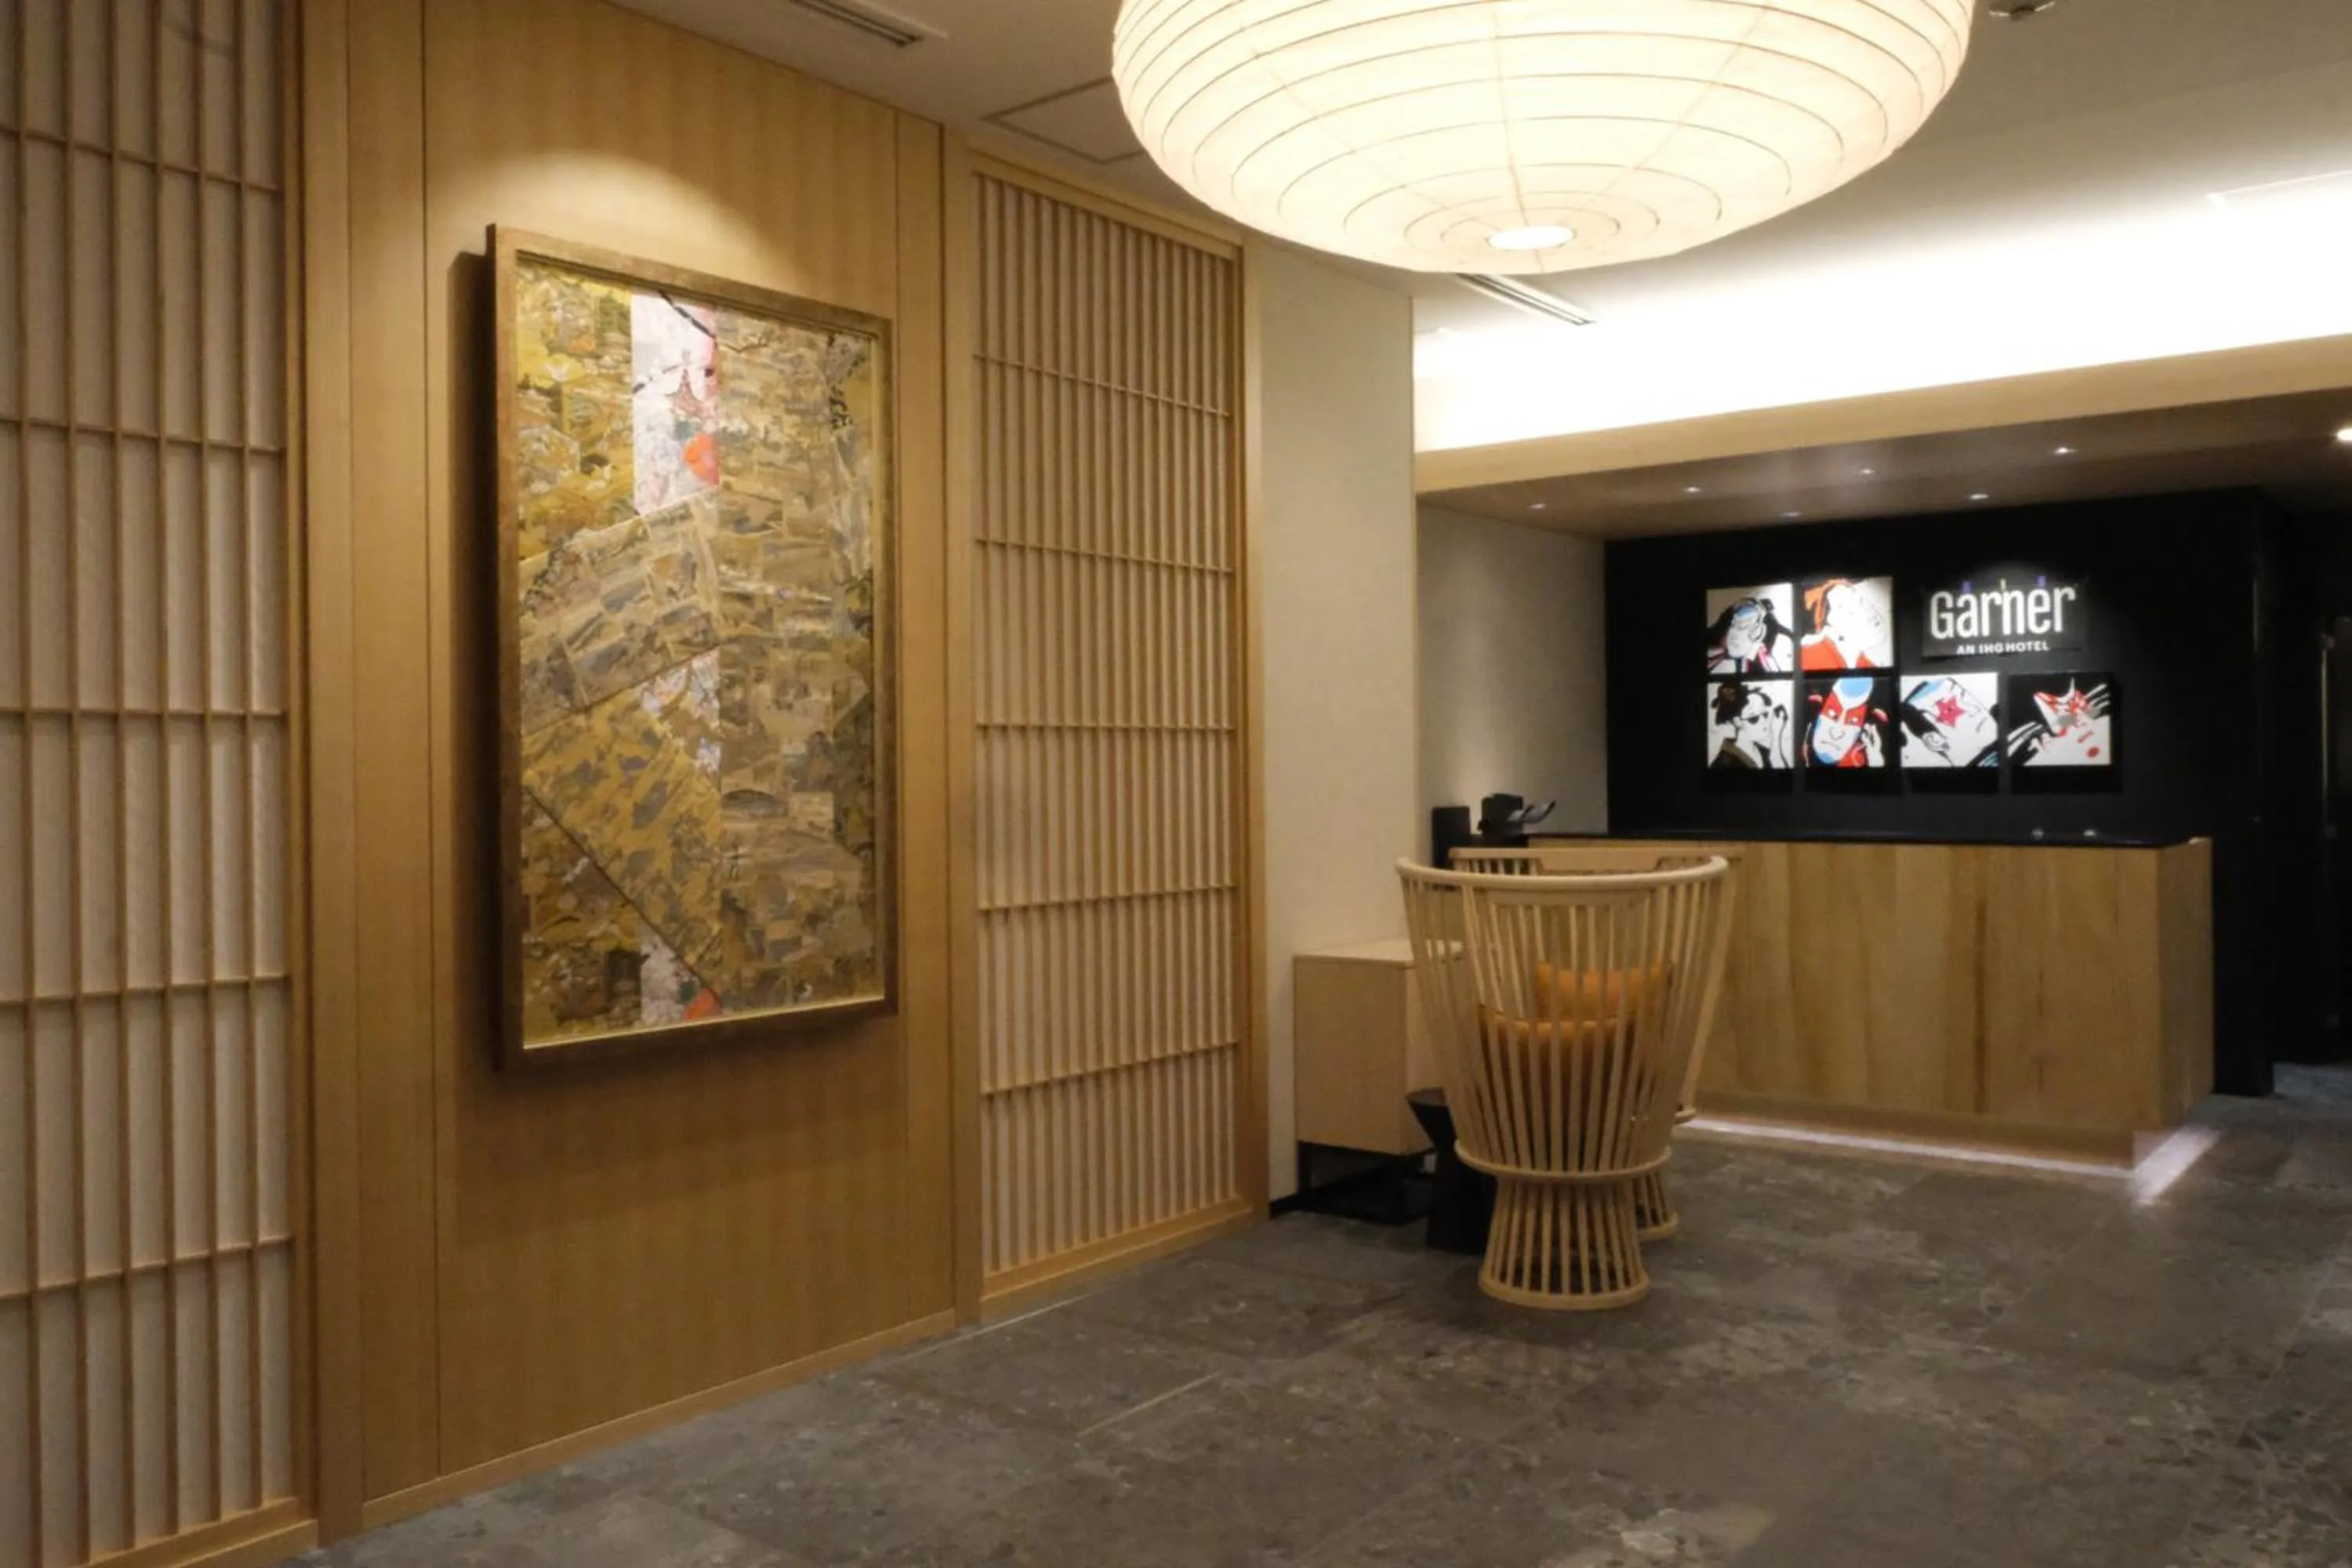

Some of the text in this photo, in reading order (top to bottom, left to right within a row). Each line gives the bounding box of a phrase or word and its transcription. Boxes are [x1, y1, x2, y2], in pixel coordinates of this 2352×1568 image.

[1930, 586, 2077, 640] Garner
[1956, 640, 2049, 655] AN IHG HOTEL
